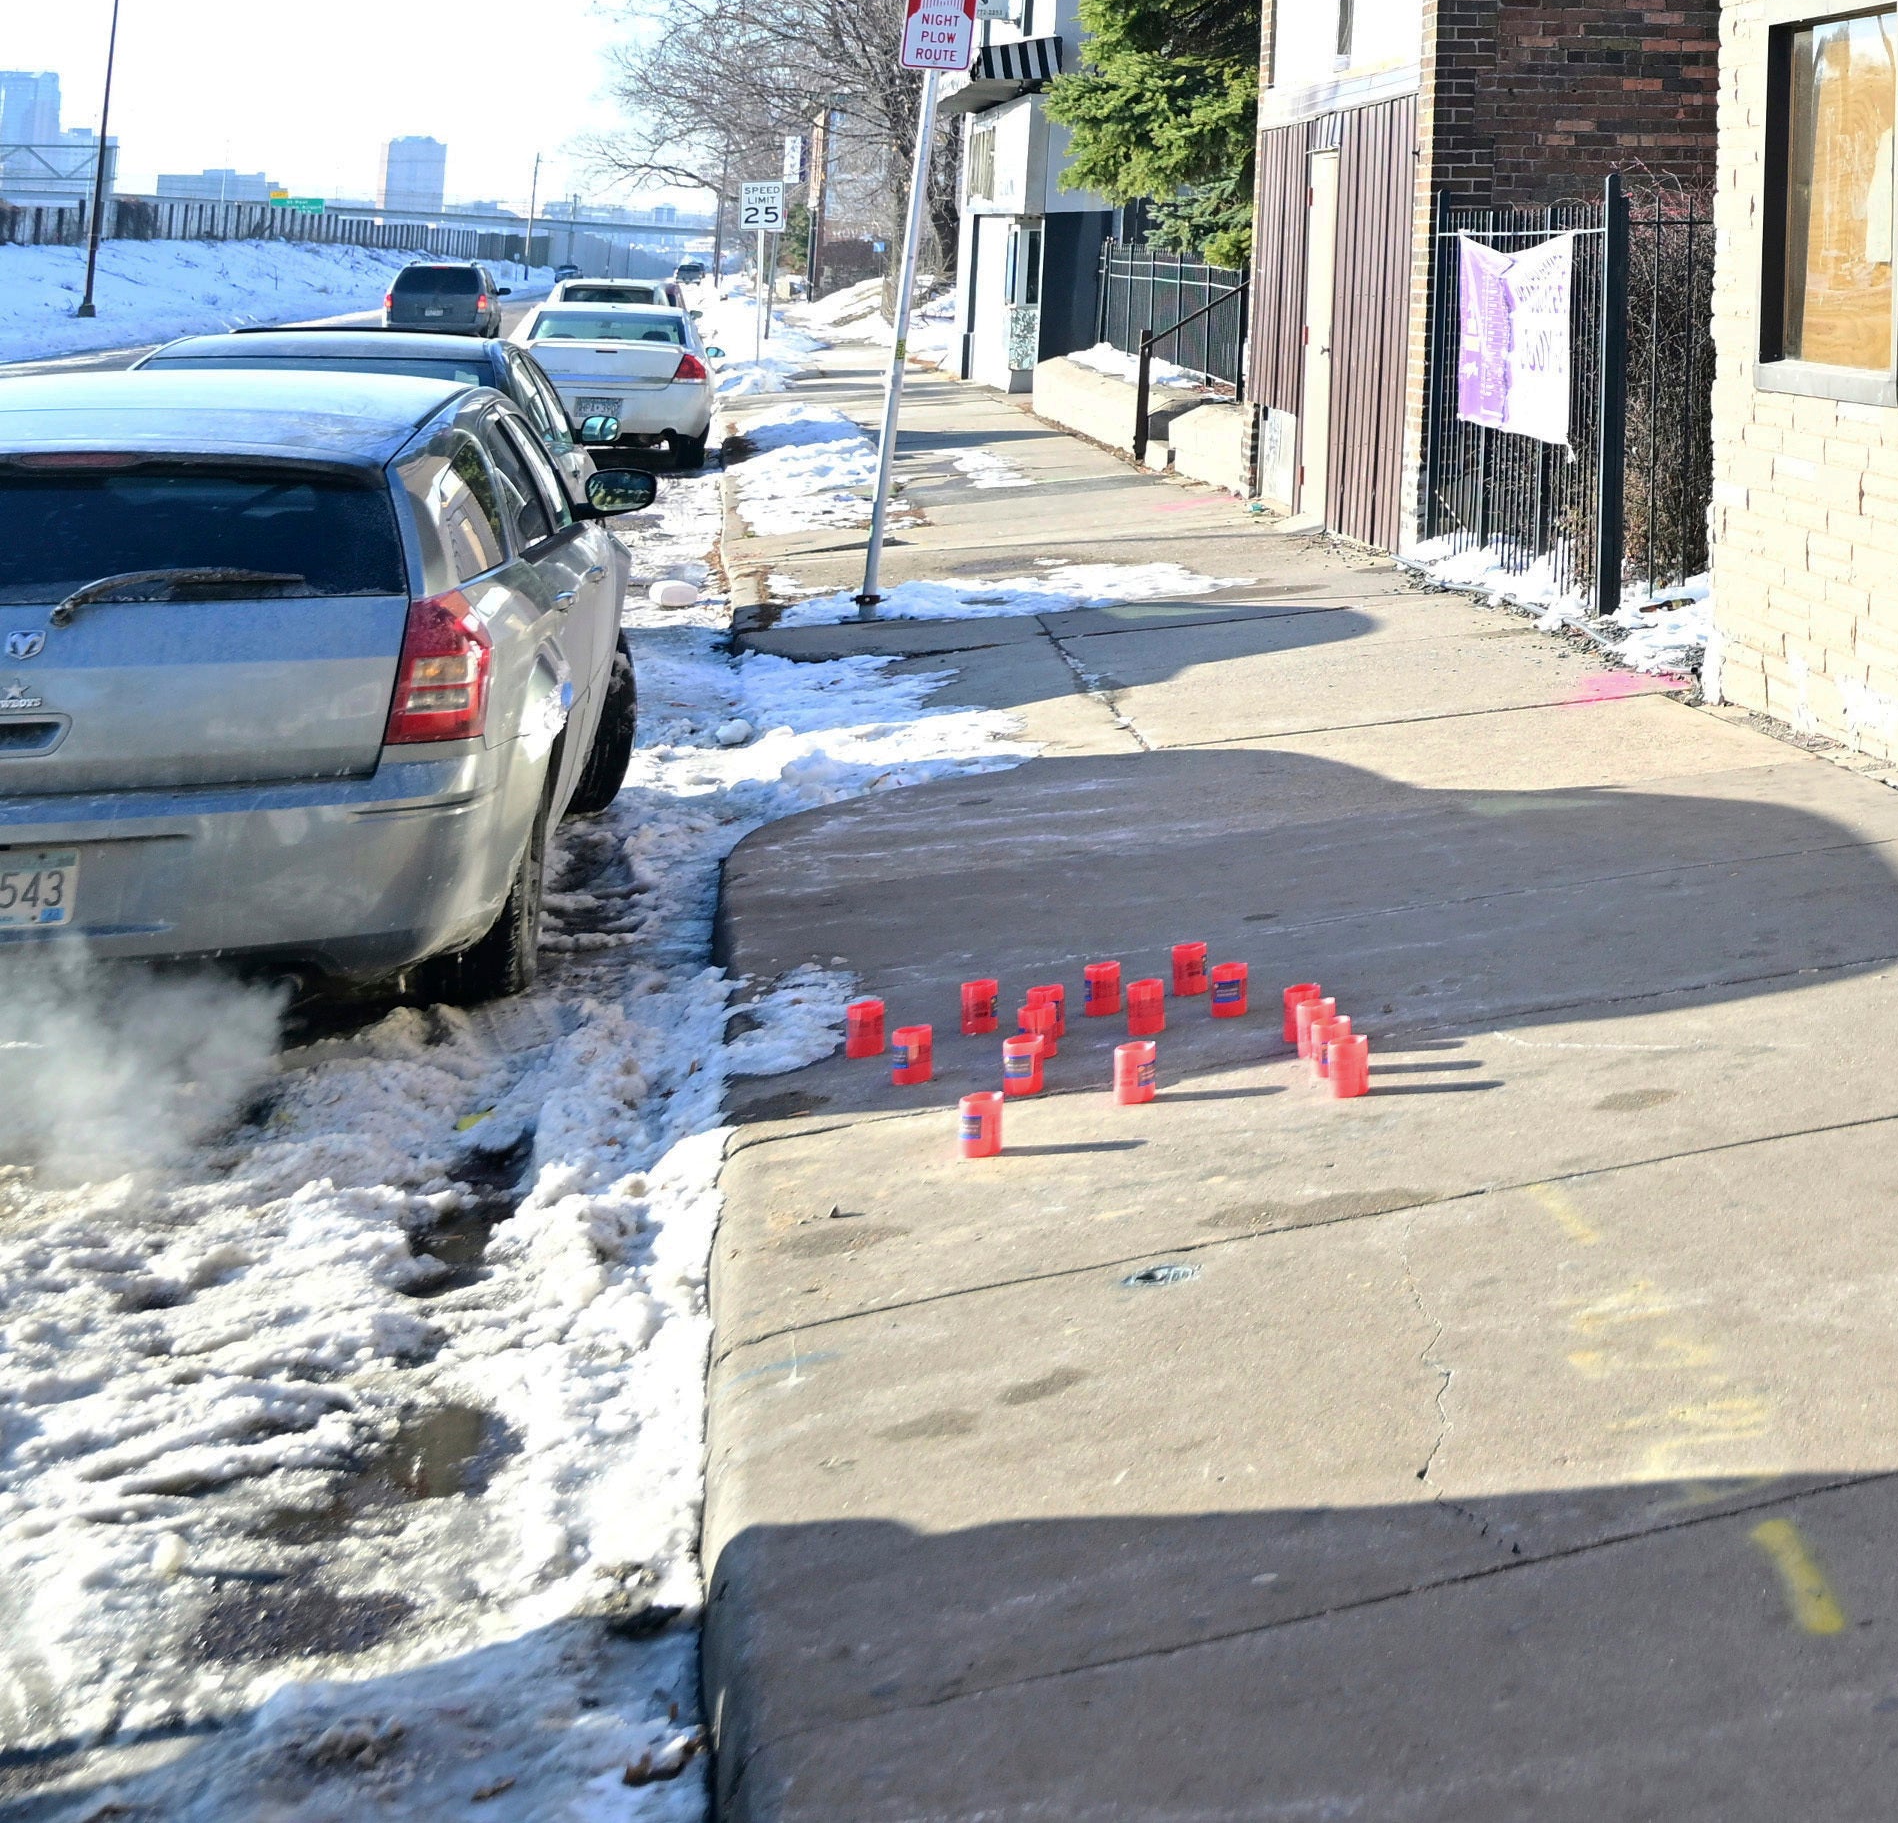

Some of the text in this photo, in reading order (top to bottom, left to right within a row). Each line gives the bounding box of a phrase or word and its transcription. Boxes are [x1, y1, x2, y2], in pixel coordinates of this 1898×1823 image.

[921, 13, 960, 27] NIGHT
[921, 31, 957, 44] PLOW
[915, 48, 958, 62] ROUTE
[744, 186, 780, 195] SPEED
[747, 196, 776, 204] LIMIT
[744, 206, 779, 224] 25
[0, 870, 65, 909] 543
